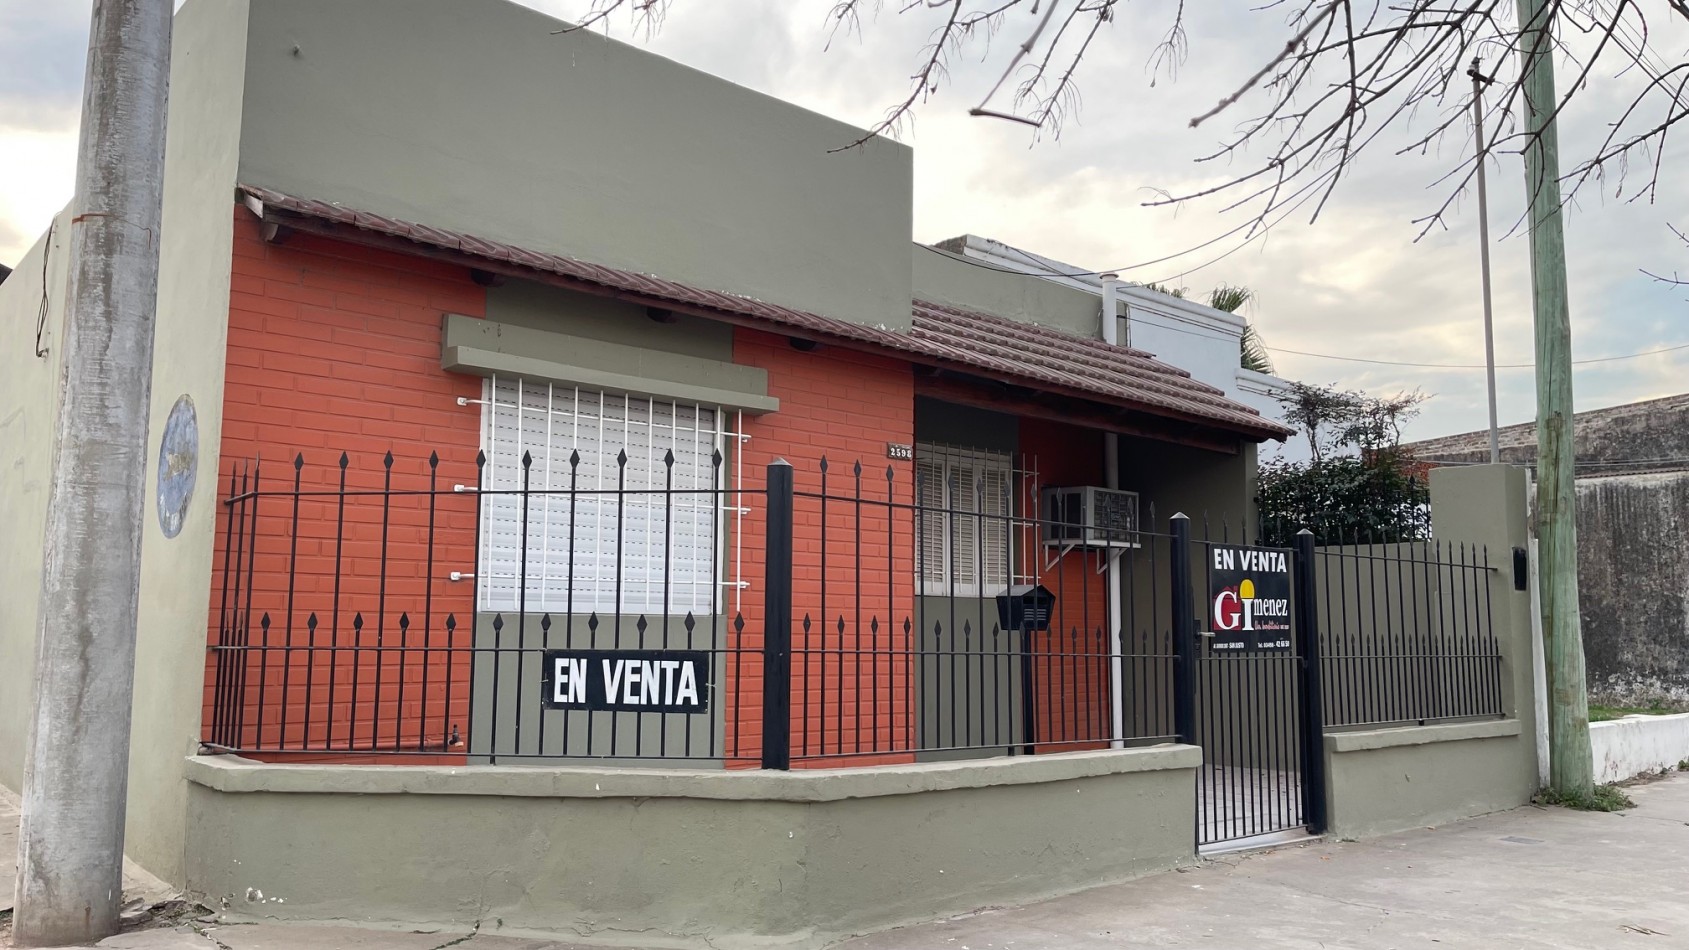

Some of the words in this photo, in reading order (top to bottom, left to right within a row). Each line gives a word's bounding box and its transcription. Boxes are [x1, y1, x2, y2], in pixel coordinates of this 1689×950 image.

[890, 447, 912, 458] 2598
[1213, 548, 1235, 570] EN
[1239, 550, 1287, 573] VENTA
[553, 658, 588, 704] EN
[602, 659, 699, 705] VENTA
